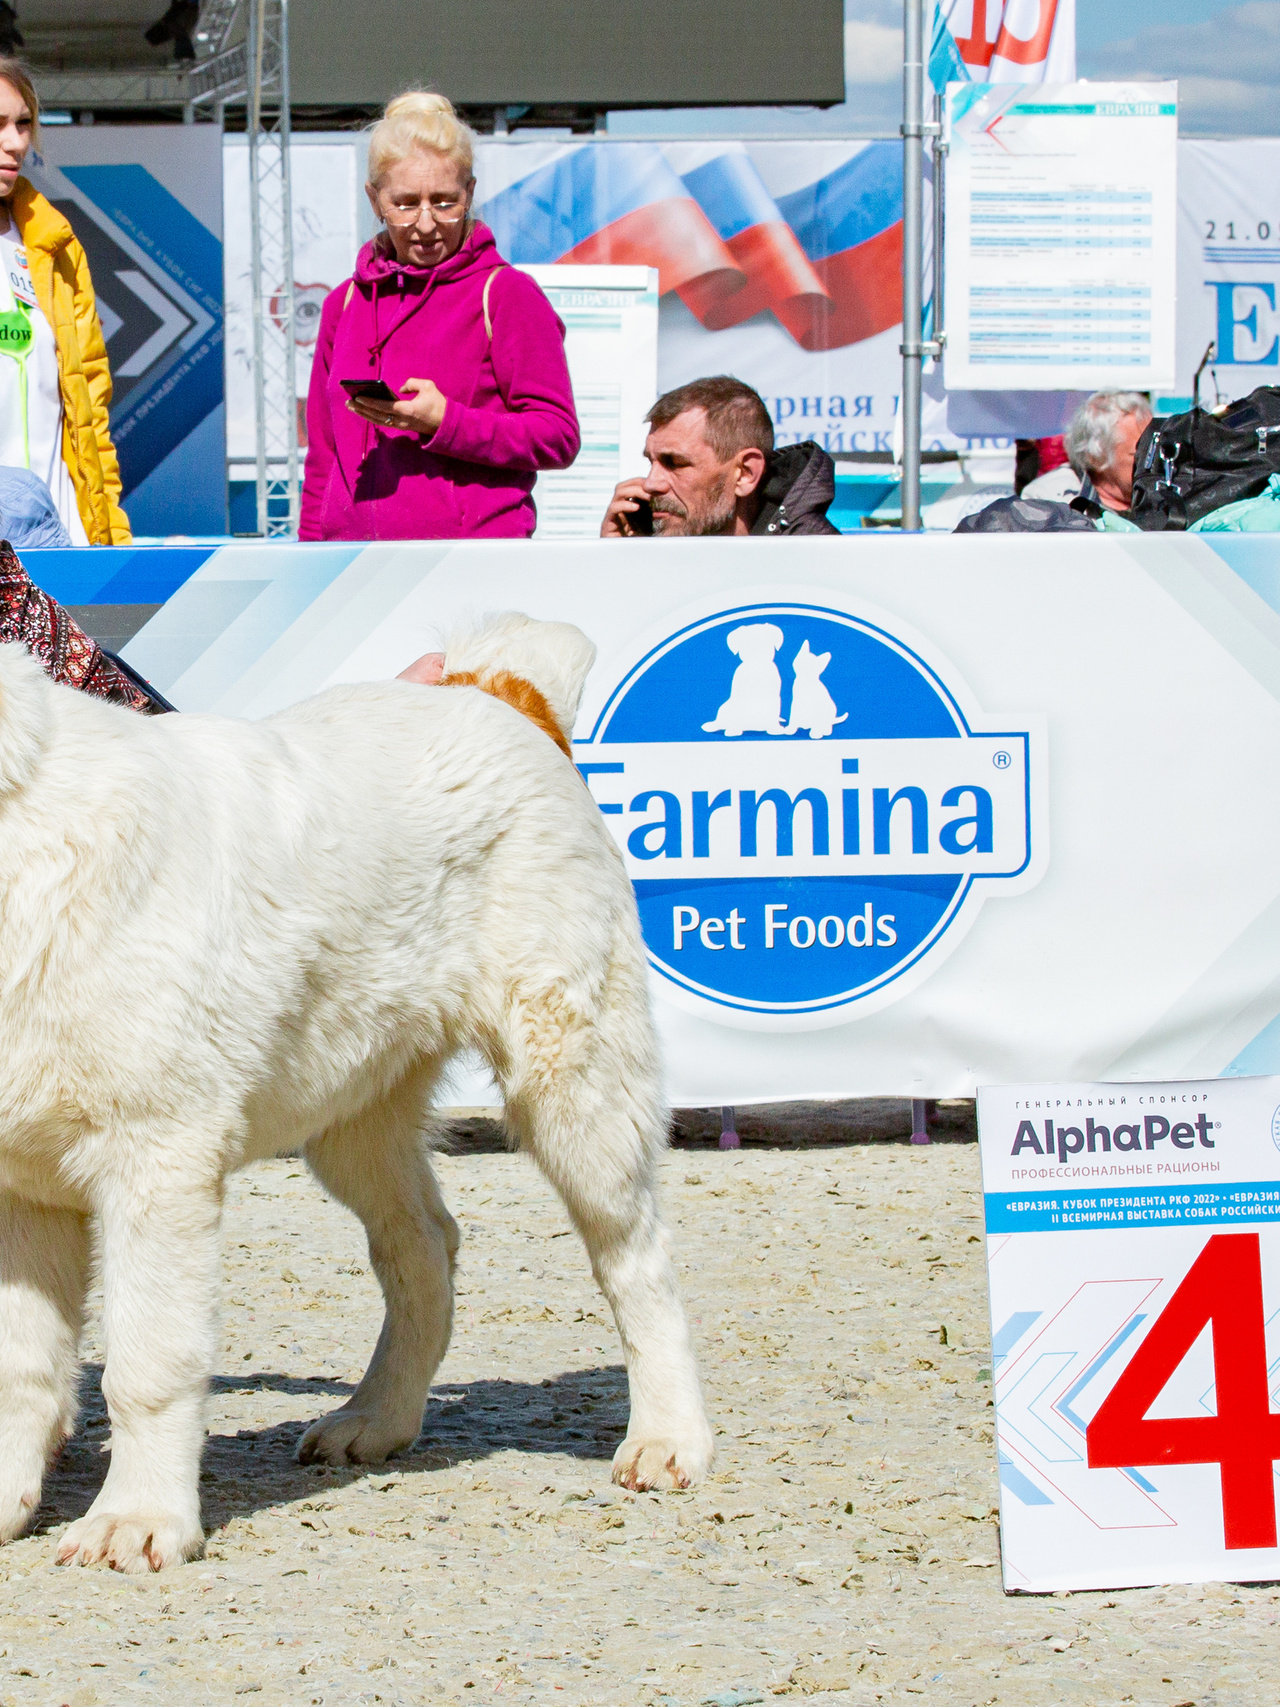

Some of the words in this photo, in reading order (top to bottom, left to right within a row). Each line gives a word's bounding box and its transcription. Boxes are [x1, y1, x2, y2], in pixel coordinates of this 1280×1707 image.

[1095, 102, 1161, 117] ЕВРАЗИЯ
[1205, 220, 1280, 240] 21.0
[764, 395, 874, 425] рная
[672, 904, 747, 950] Pet
[764, 902, 898, 949] Foods
[1015, 1096, 1127, 1109] ГЕНЕРАЛЬНЫЙ
[1139, 1094, 1209, 1105] СПОНСОР
[1010, 1113, 1216, 1164] AlphaPet
[1011, 1163, 1153, 1180] ПРОФЕССИОНАЛЬНЫЕ
[1157, 1161, 1221, 1175] РАЦИОНЫ
[1063, 1198, 1097, 1210] КУБОК
[1100, 1195, 1166, 1209] ПРЕЗИДЕНТА
[1169, 1194, 1191, 1206] РКФ
[1193, 1193, 1220, 1205] 2022»
[1062, 1210, 1124, 1223] ВСЕМИРНАЯ
[1127, 1208, 1182, 1221] ВЫСТАВКА
[1185, 1207, 1218, 1218] СОБАК
[1086, 1233, 1280, 1551] 4
